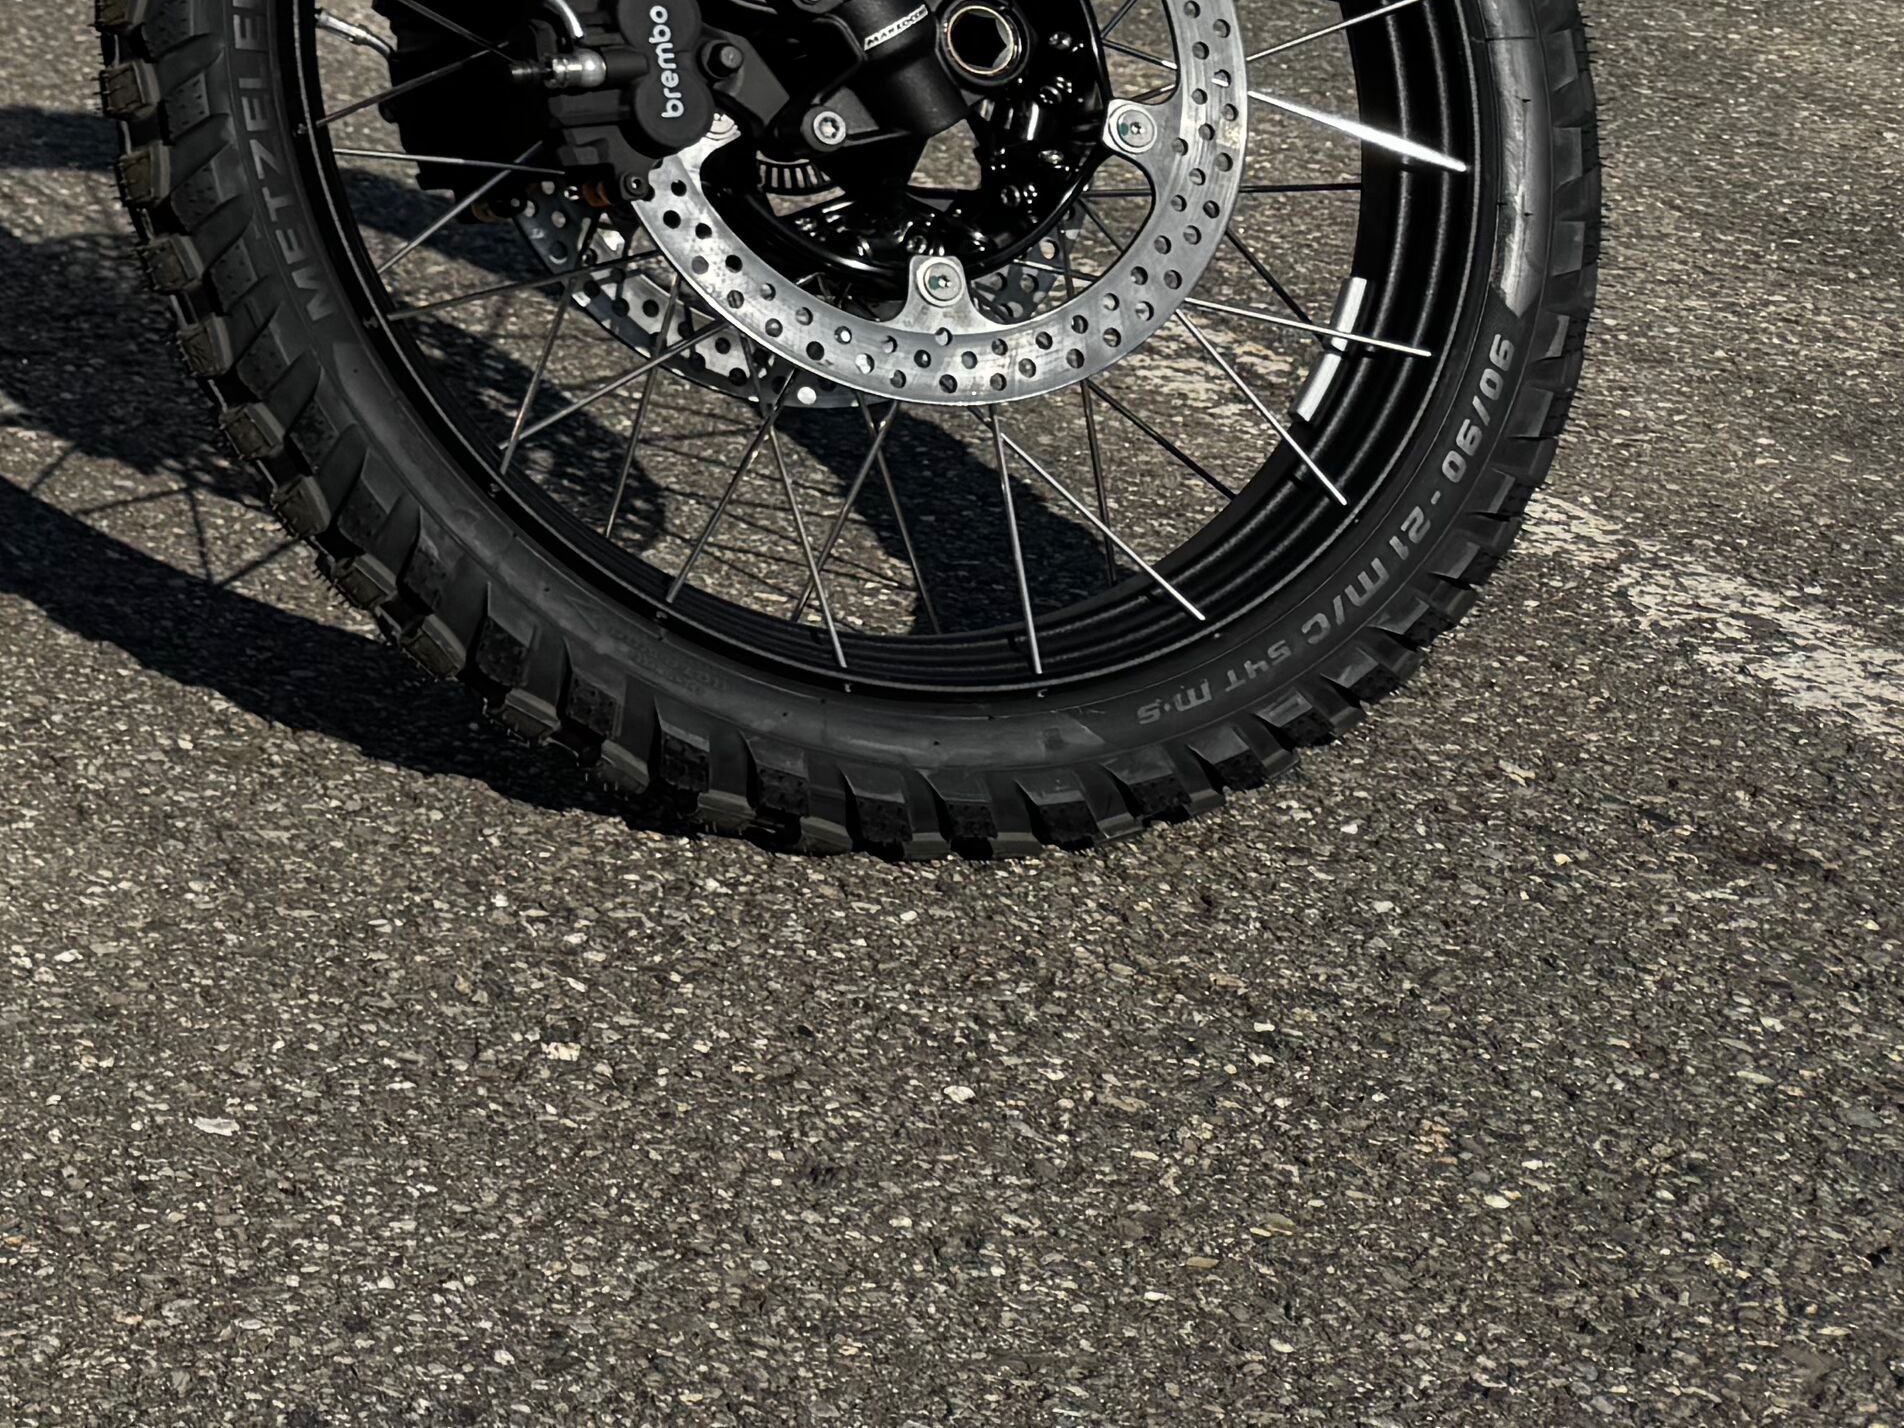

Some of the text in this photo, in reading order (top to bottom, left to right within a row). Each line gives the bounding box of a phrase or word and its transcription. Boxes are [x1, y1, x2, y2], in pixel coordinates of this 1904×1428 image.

[647, 3, 689, 122] brembo
[1442, 333, 1515, 484] 90/90
[1388, 506, 1432, 561] 21
[1301, 559, 1386, 645] M/C
[1224, 639, 1292, 691] 54T
